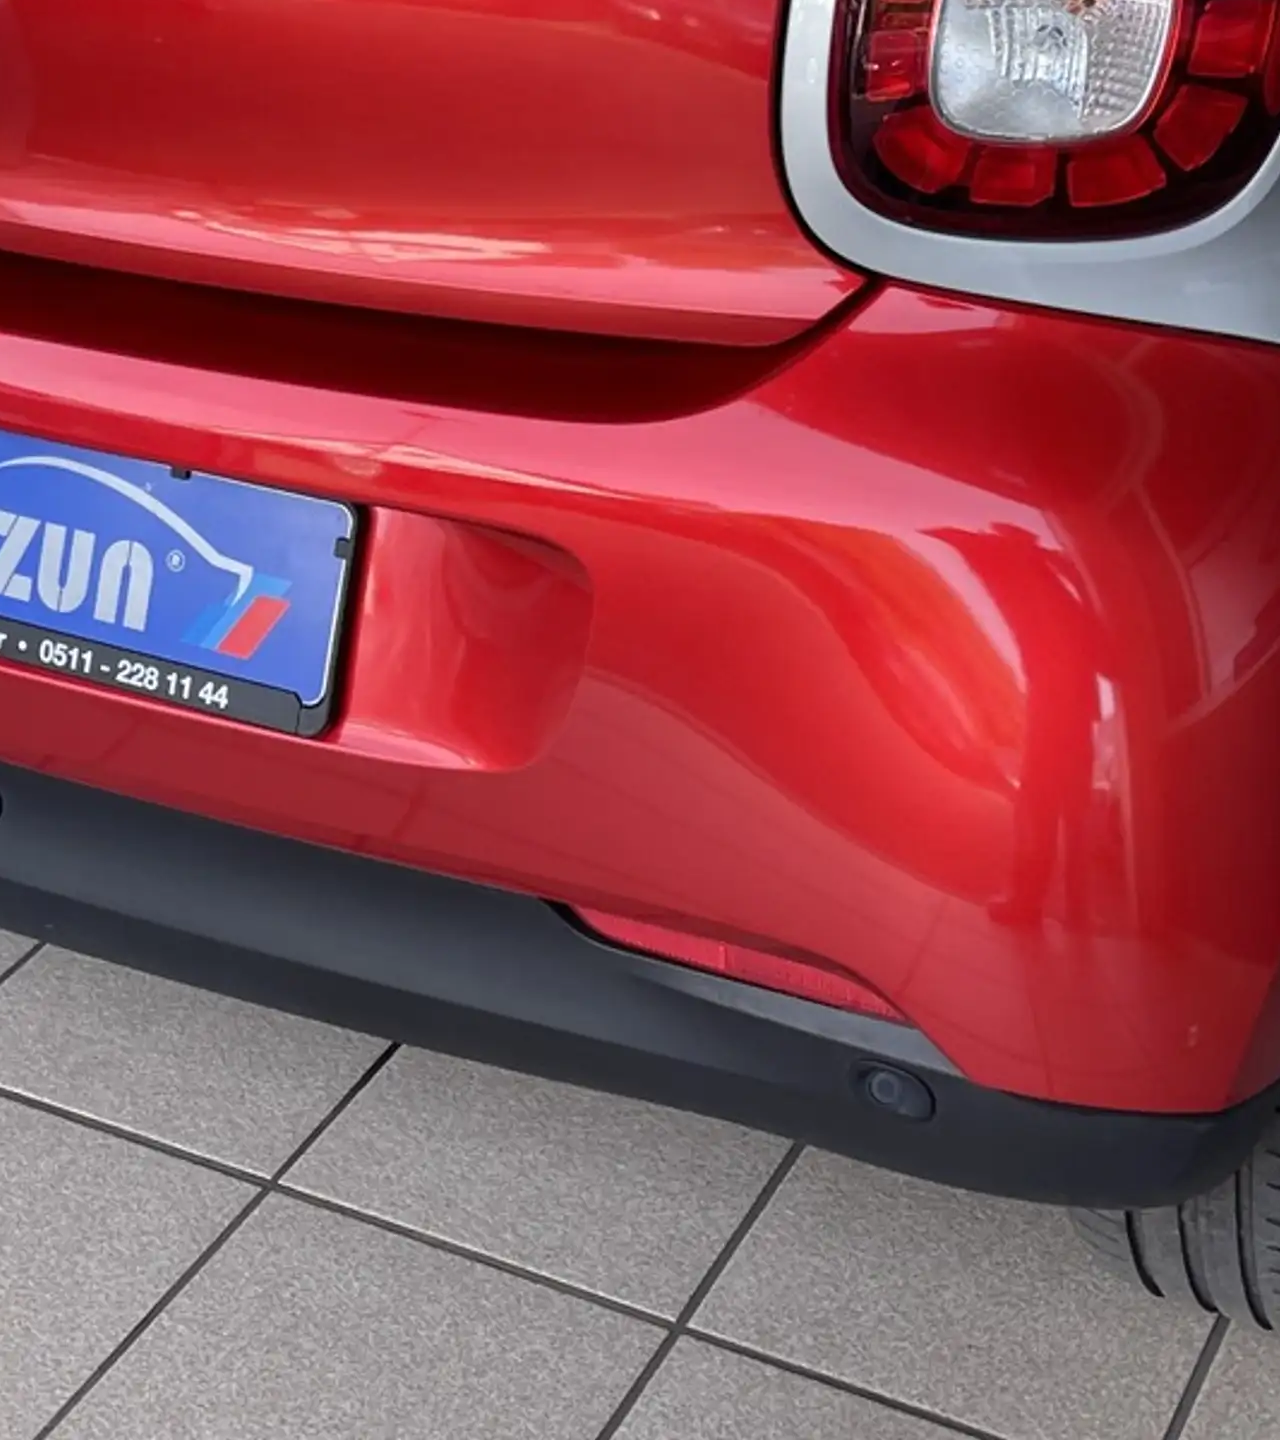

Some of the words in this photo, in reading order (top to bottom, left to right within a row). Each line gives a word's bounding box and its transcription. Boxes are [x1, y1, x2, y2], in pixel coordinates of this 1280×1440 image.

[39, 638, 94, 675] 0511
[116, 659, 159, 691] 228
[167, 672, 192, 700] 11
[198, 684, 229, 710] 44
